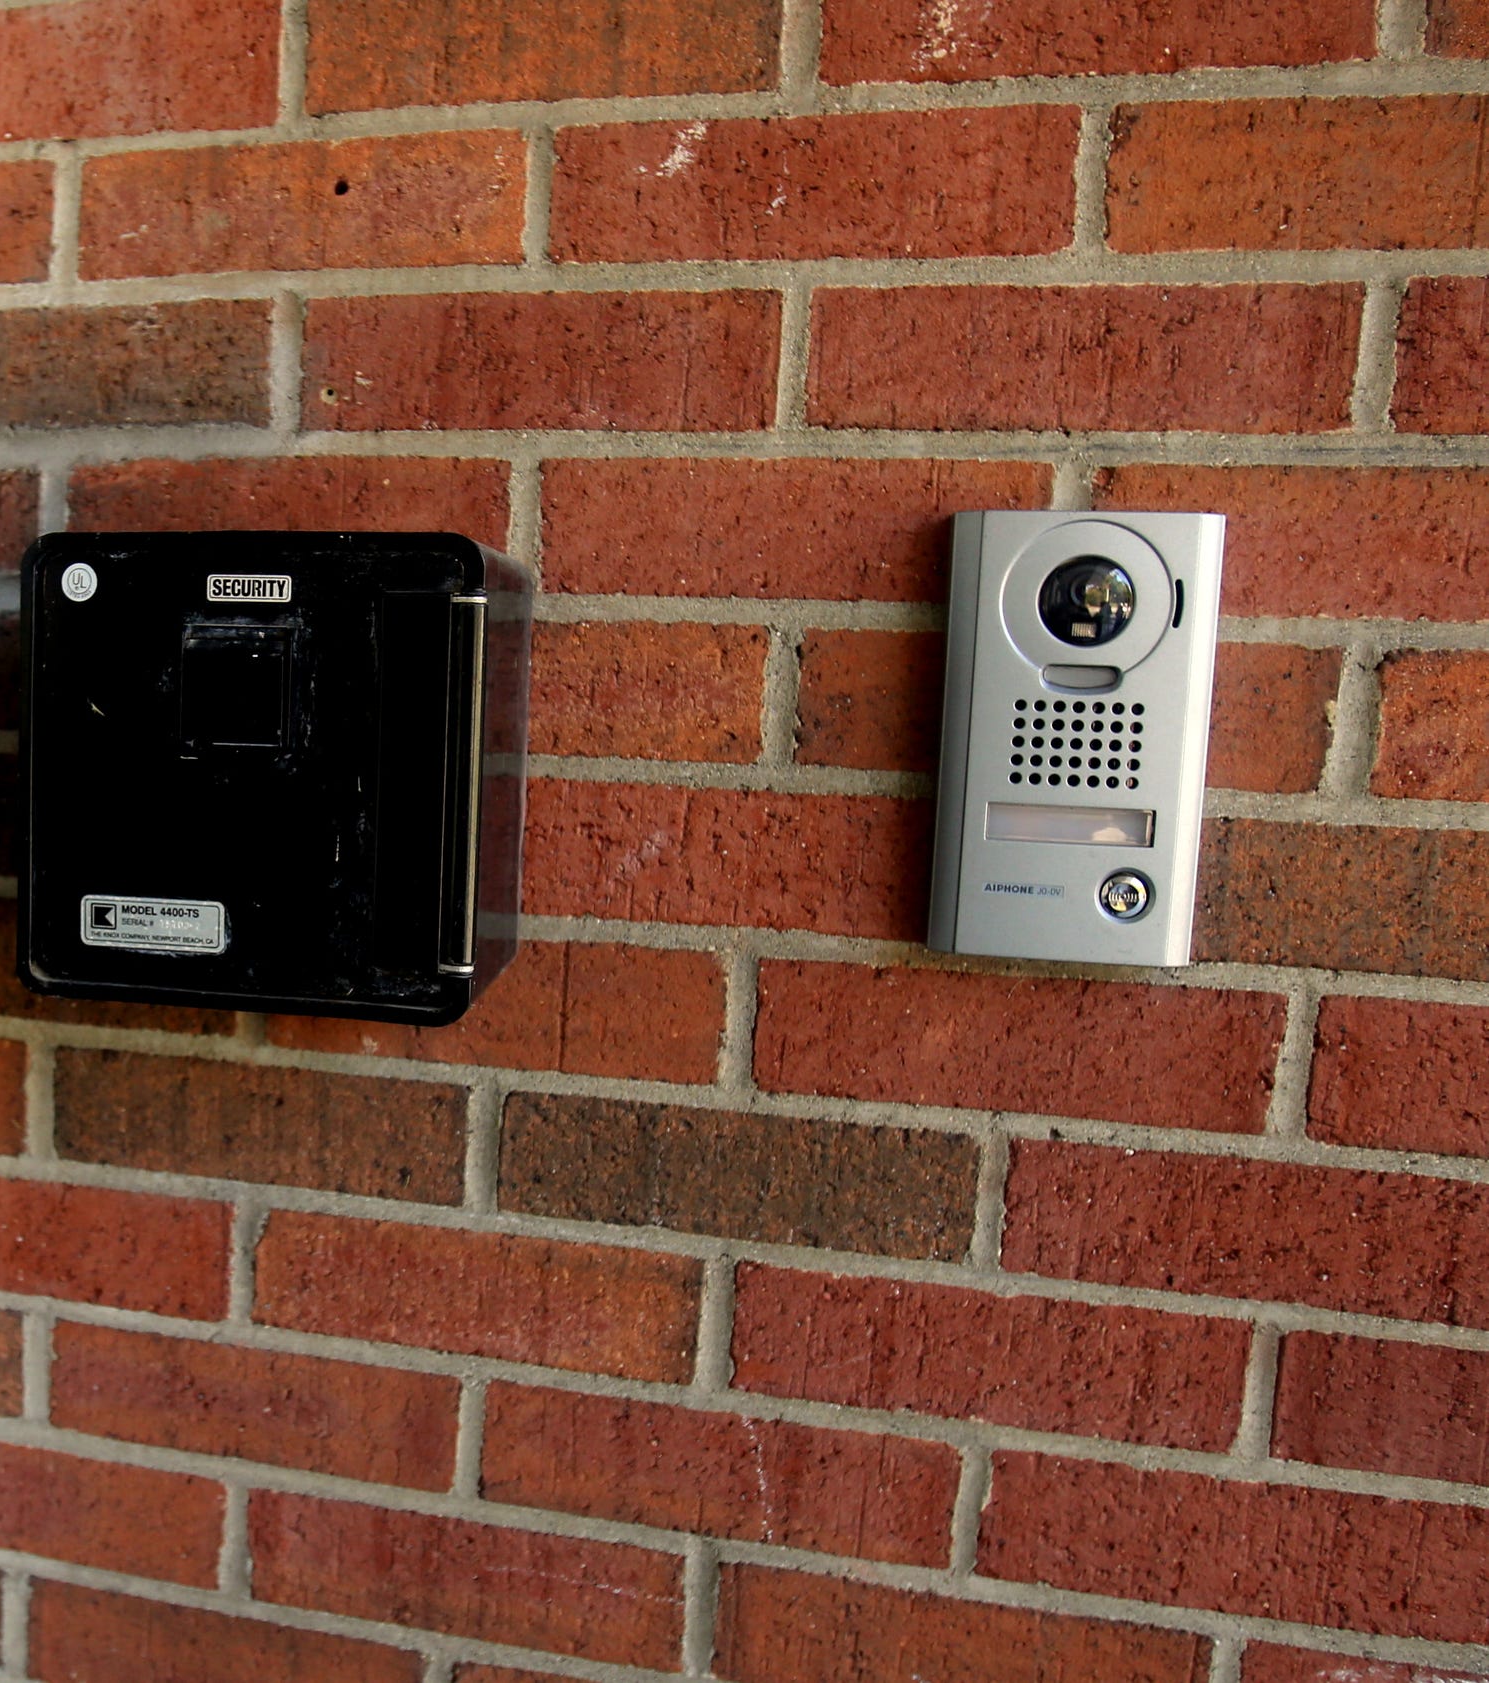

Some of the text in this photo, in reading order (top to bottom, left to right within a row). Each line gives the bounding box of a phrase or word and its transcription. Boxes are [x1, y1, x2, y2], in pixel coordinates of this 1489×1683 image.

[73, 573, 86, 589] UL
[212, 579, 286, 597] SECURITY
[984, 883, 1034, 895] AIPHONE
[121, 905, 200, 919] MODEL 4400-TS
[121, 917, 148, 927] SERIAL
[103, 931, 119, 939] KNOX
[152, 935, 180, 943] NEWPORT
